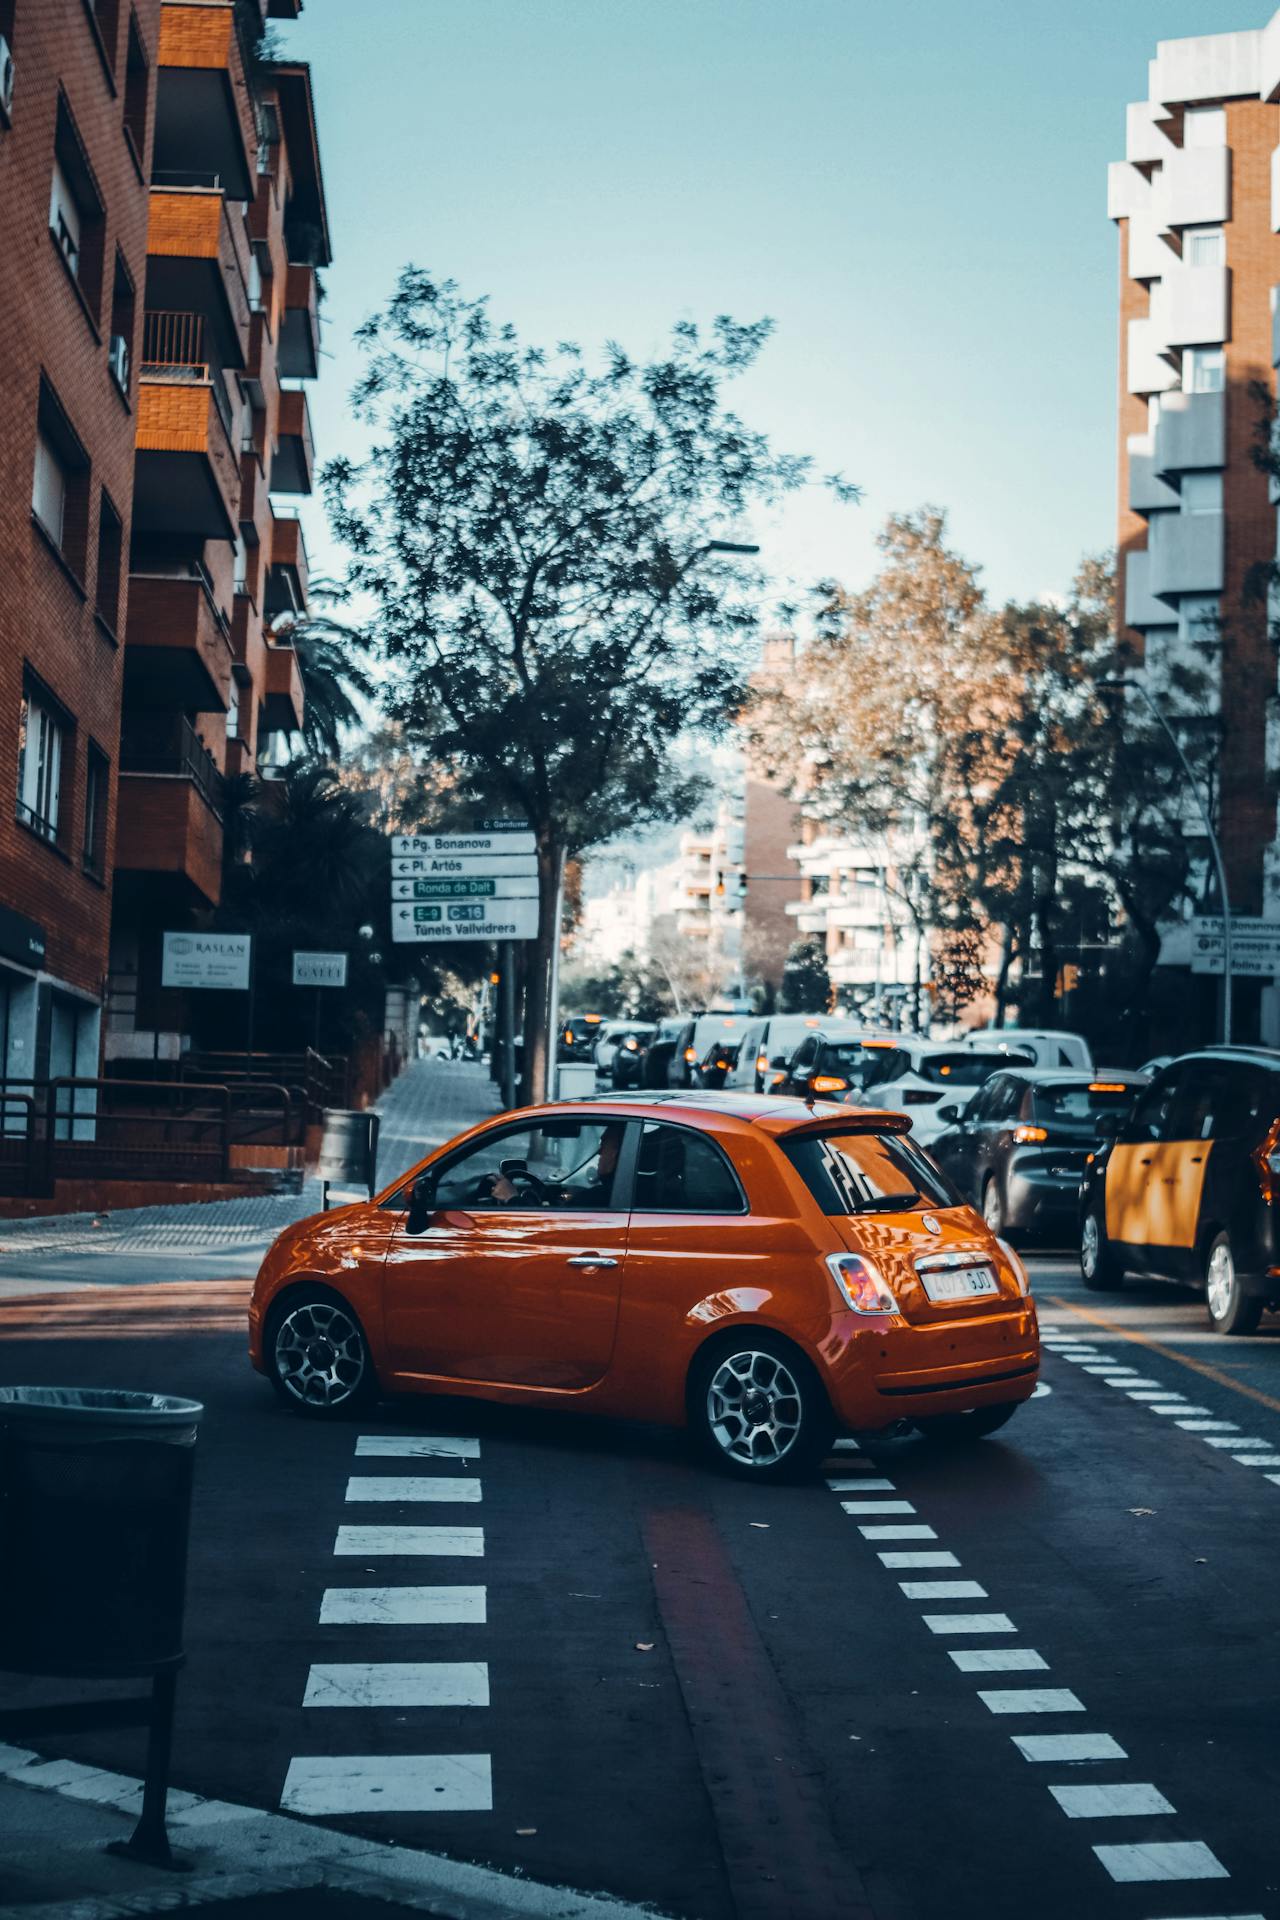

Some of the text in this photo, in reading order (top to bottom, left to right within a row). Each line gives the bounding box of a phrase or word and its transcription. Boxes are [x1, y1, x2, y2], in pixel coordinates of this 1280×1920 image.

[412, 838, 492, 852] Pg. Bonanova
[412, 860, 463, 872] Pl. Artós
[417, 881, 492, 894] Ronda de Dalt
[416, 906, 483, 920] E-9 C-16
[414, 923, 517, 936] Túnels Vallvidrera
[195, 943, 246, 954] RASLAN
